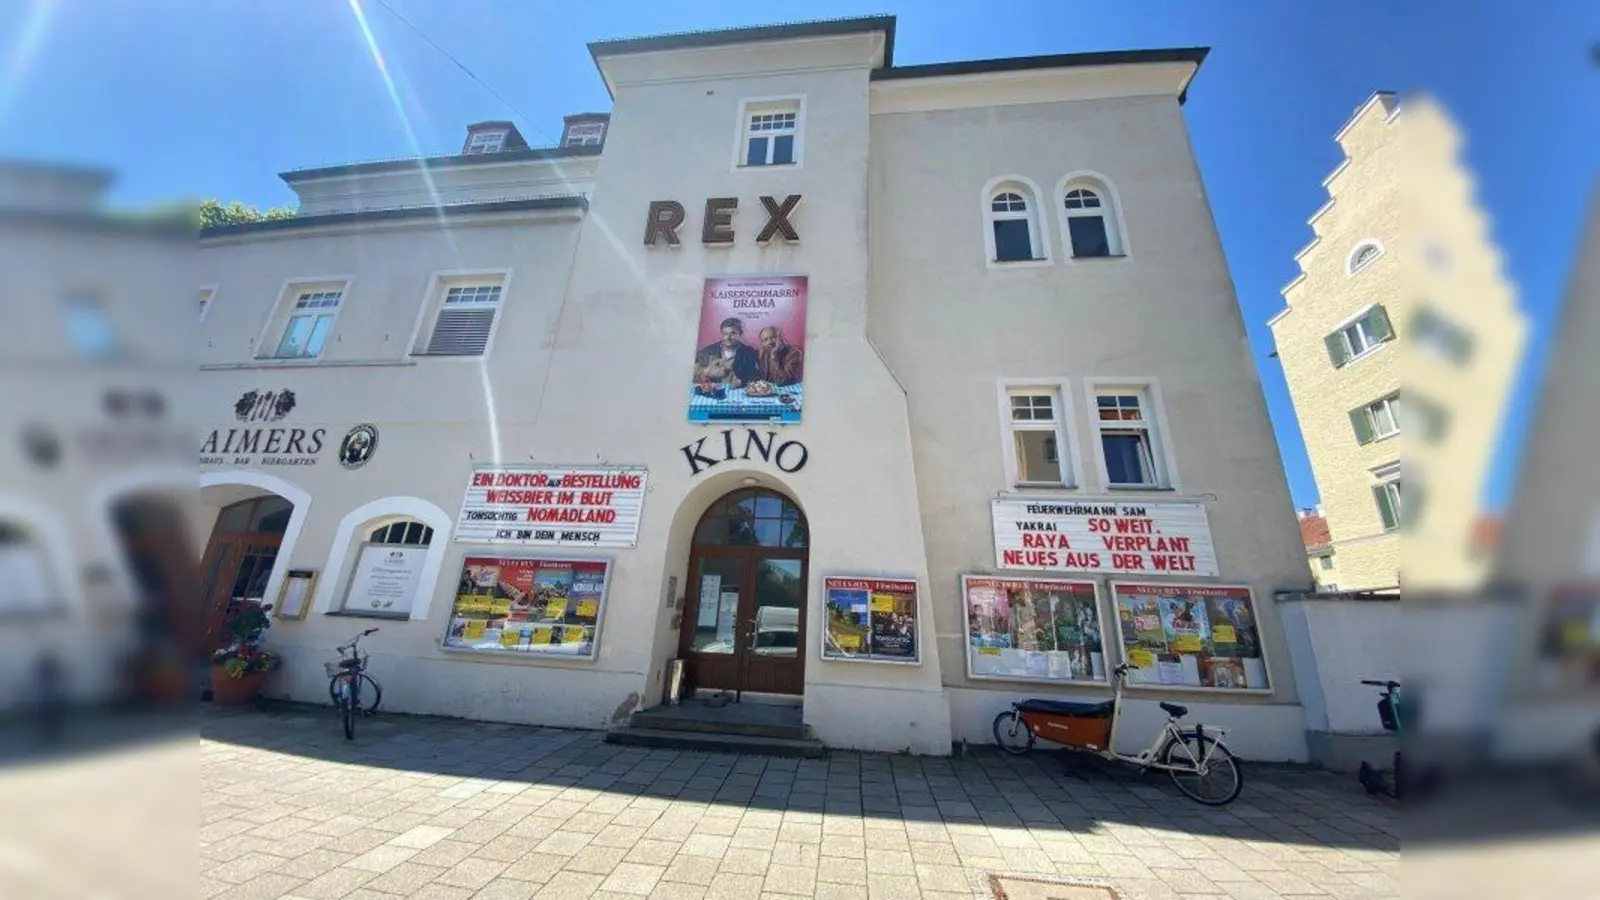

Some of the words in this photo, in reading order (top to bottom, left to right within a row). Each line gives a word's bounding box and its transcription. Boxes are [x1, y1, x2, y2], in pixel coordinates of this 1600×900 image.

[644, 195, 802, 245] REX
[732, 298, 776, 309] DRAMA
[680, 428, 808, 476] KINO
[473, 473, 494, 487] EIN
[495, 474, 548, 488] DOKTOR
[562, 475, 640, 489] BESTELLUNG
[486, 490, 554, 504] WEISSBIER
[557, 491, 574, 505] IM
[580, 492, 615, 506] BLUT
[526, 507, 617, 523] NOMADLAND
[1026, 504, 1118, 516] FEUERWEHRMANN
[1122, 506, 1147, 517] SAM
[1015, 520, 1058, 532] YAKRAI
[1088, 518, 1111, 534] SO
[495, 529, 512, 539] ICH
[516, 530, 533, 540] BIN
[535, 530, 556, 540] DEIN
[560, 531, 601, 541] MENSCH
[1022, 533, 1071, 550] RAYA
[1102, 535, 1191, 554] VERPLANT
[1003, 549, 1059, 567] NEUES
[1065, 552, 1102, 569] AUS
[1111, 553, 1145, 570] DER
[1150, 555, 1197, 572] WELT
